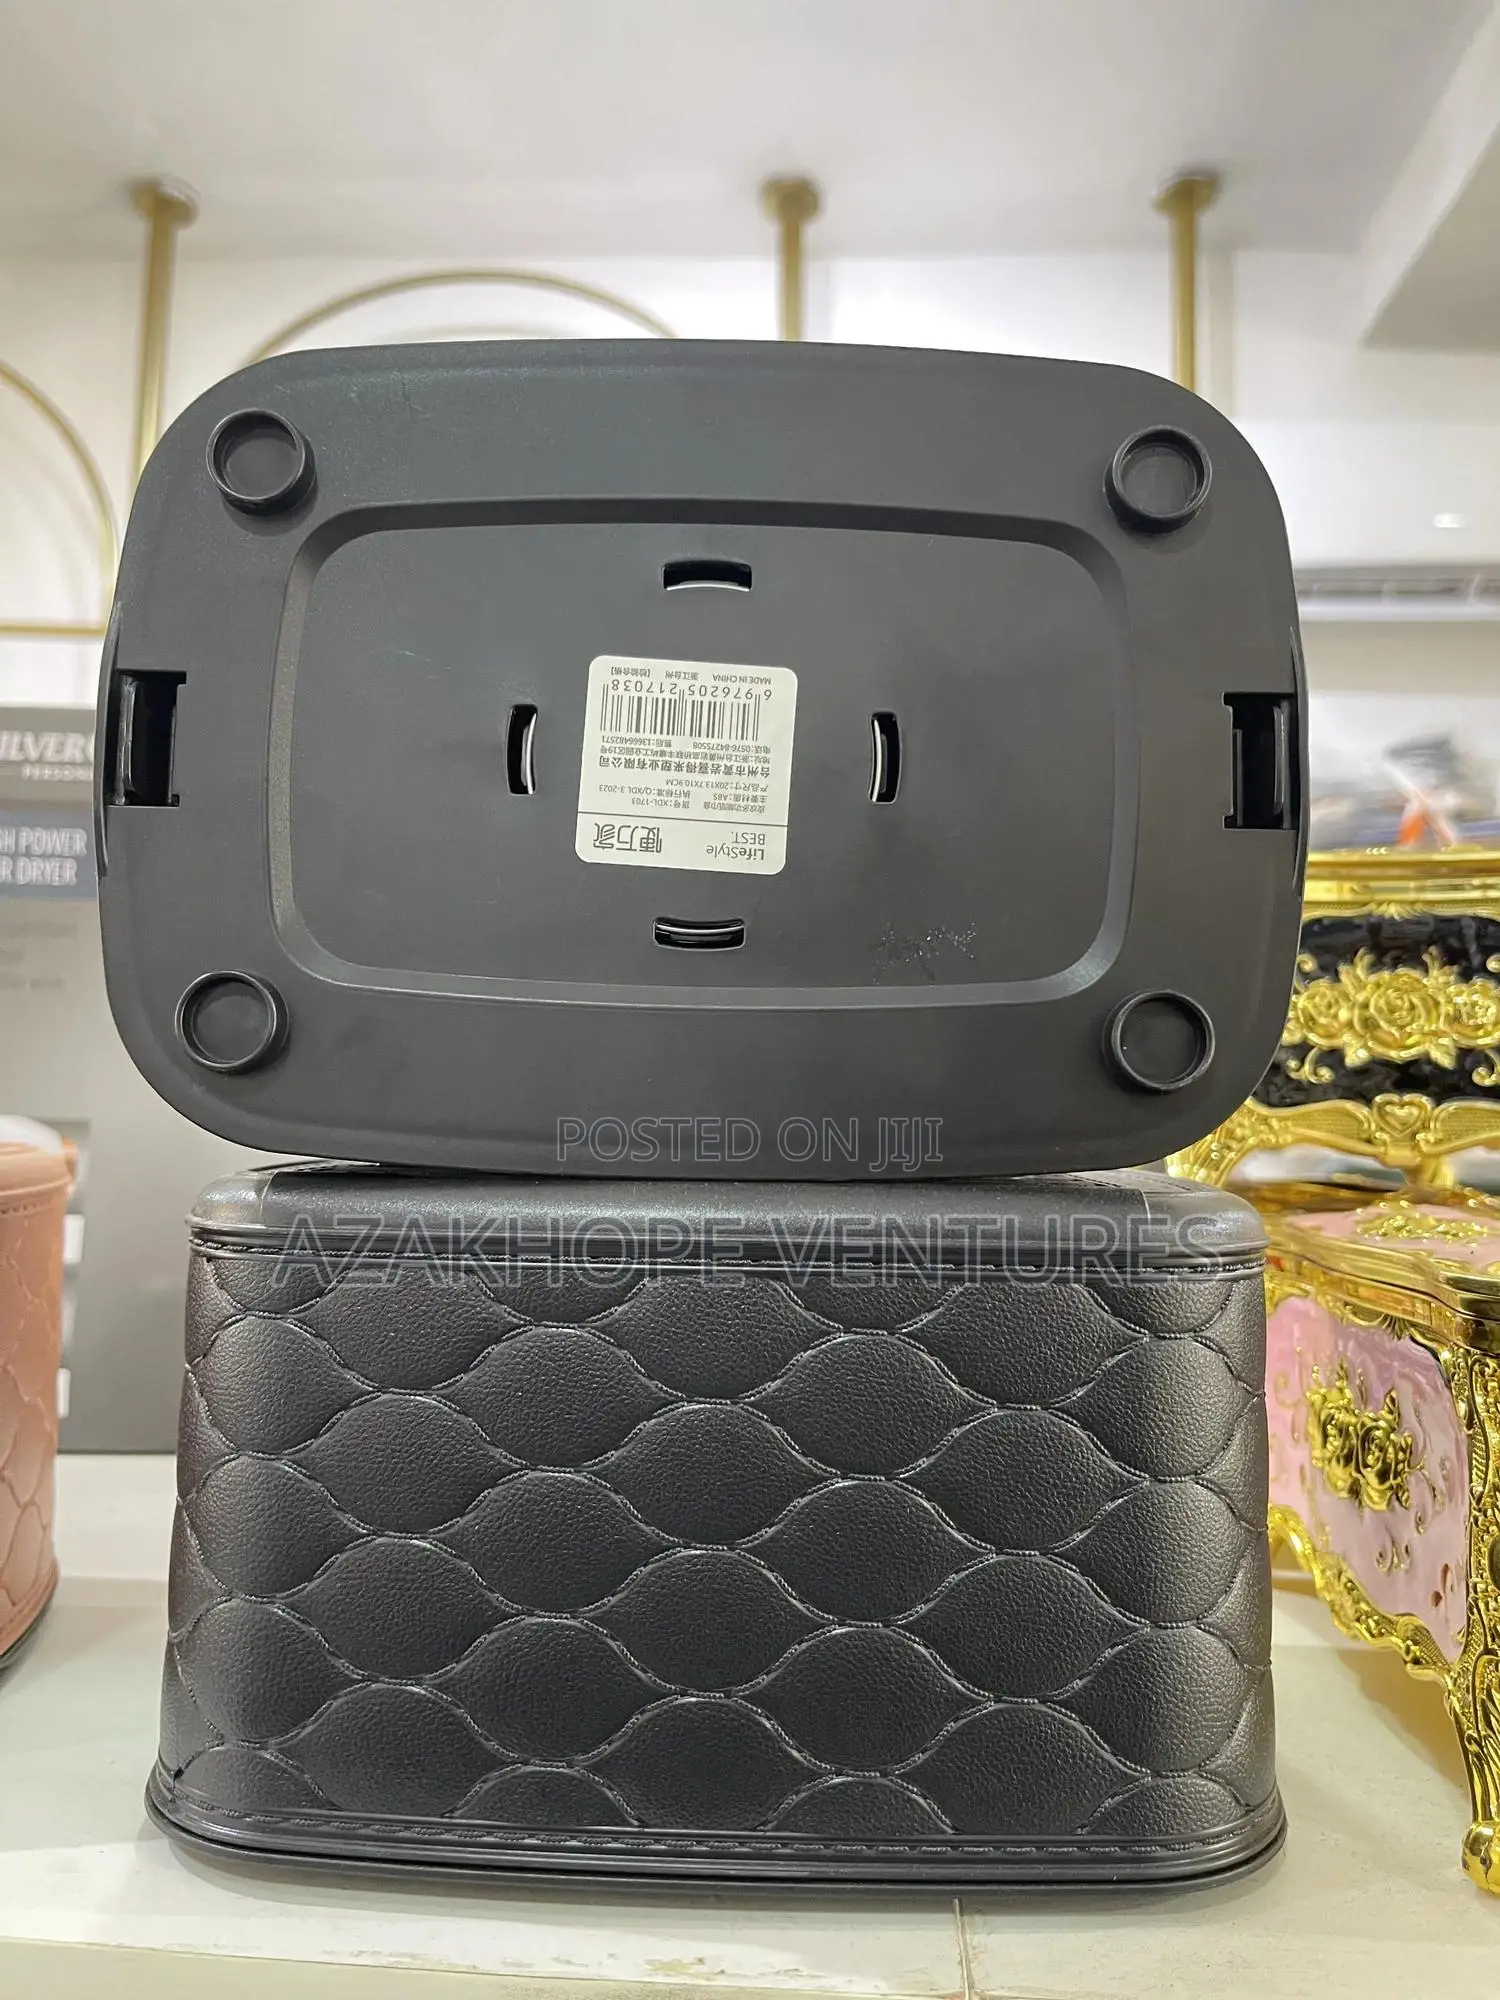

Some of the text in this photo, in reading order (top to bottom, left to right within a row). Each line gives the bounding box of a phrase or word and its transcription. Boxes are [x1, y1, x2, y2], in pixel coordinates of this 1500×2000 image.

[665, 670, 698, 680] 浙江台州
[712, 673, 771, 684] MADE IN CHINA
[598, 755, 770, 778] 台州市黄岩喜得来塑业有限公司
[18, 826, 87, 856] POWER
[592, 822, 662, 853] 便万家
[705, 841, 764, 860] LifeStyle
[16, 856, 77, 886] DRYER
